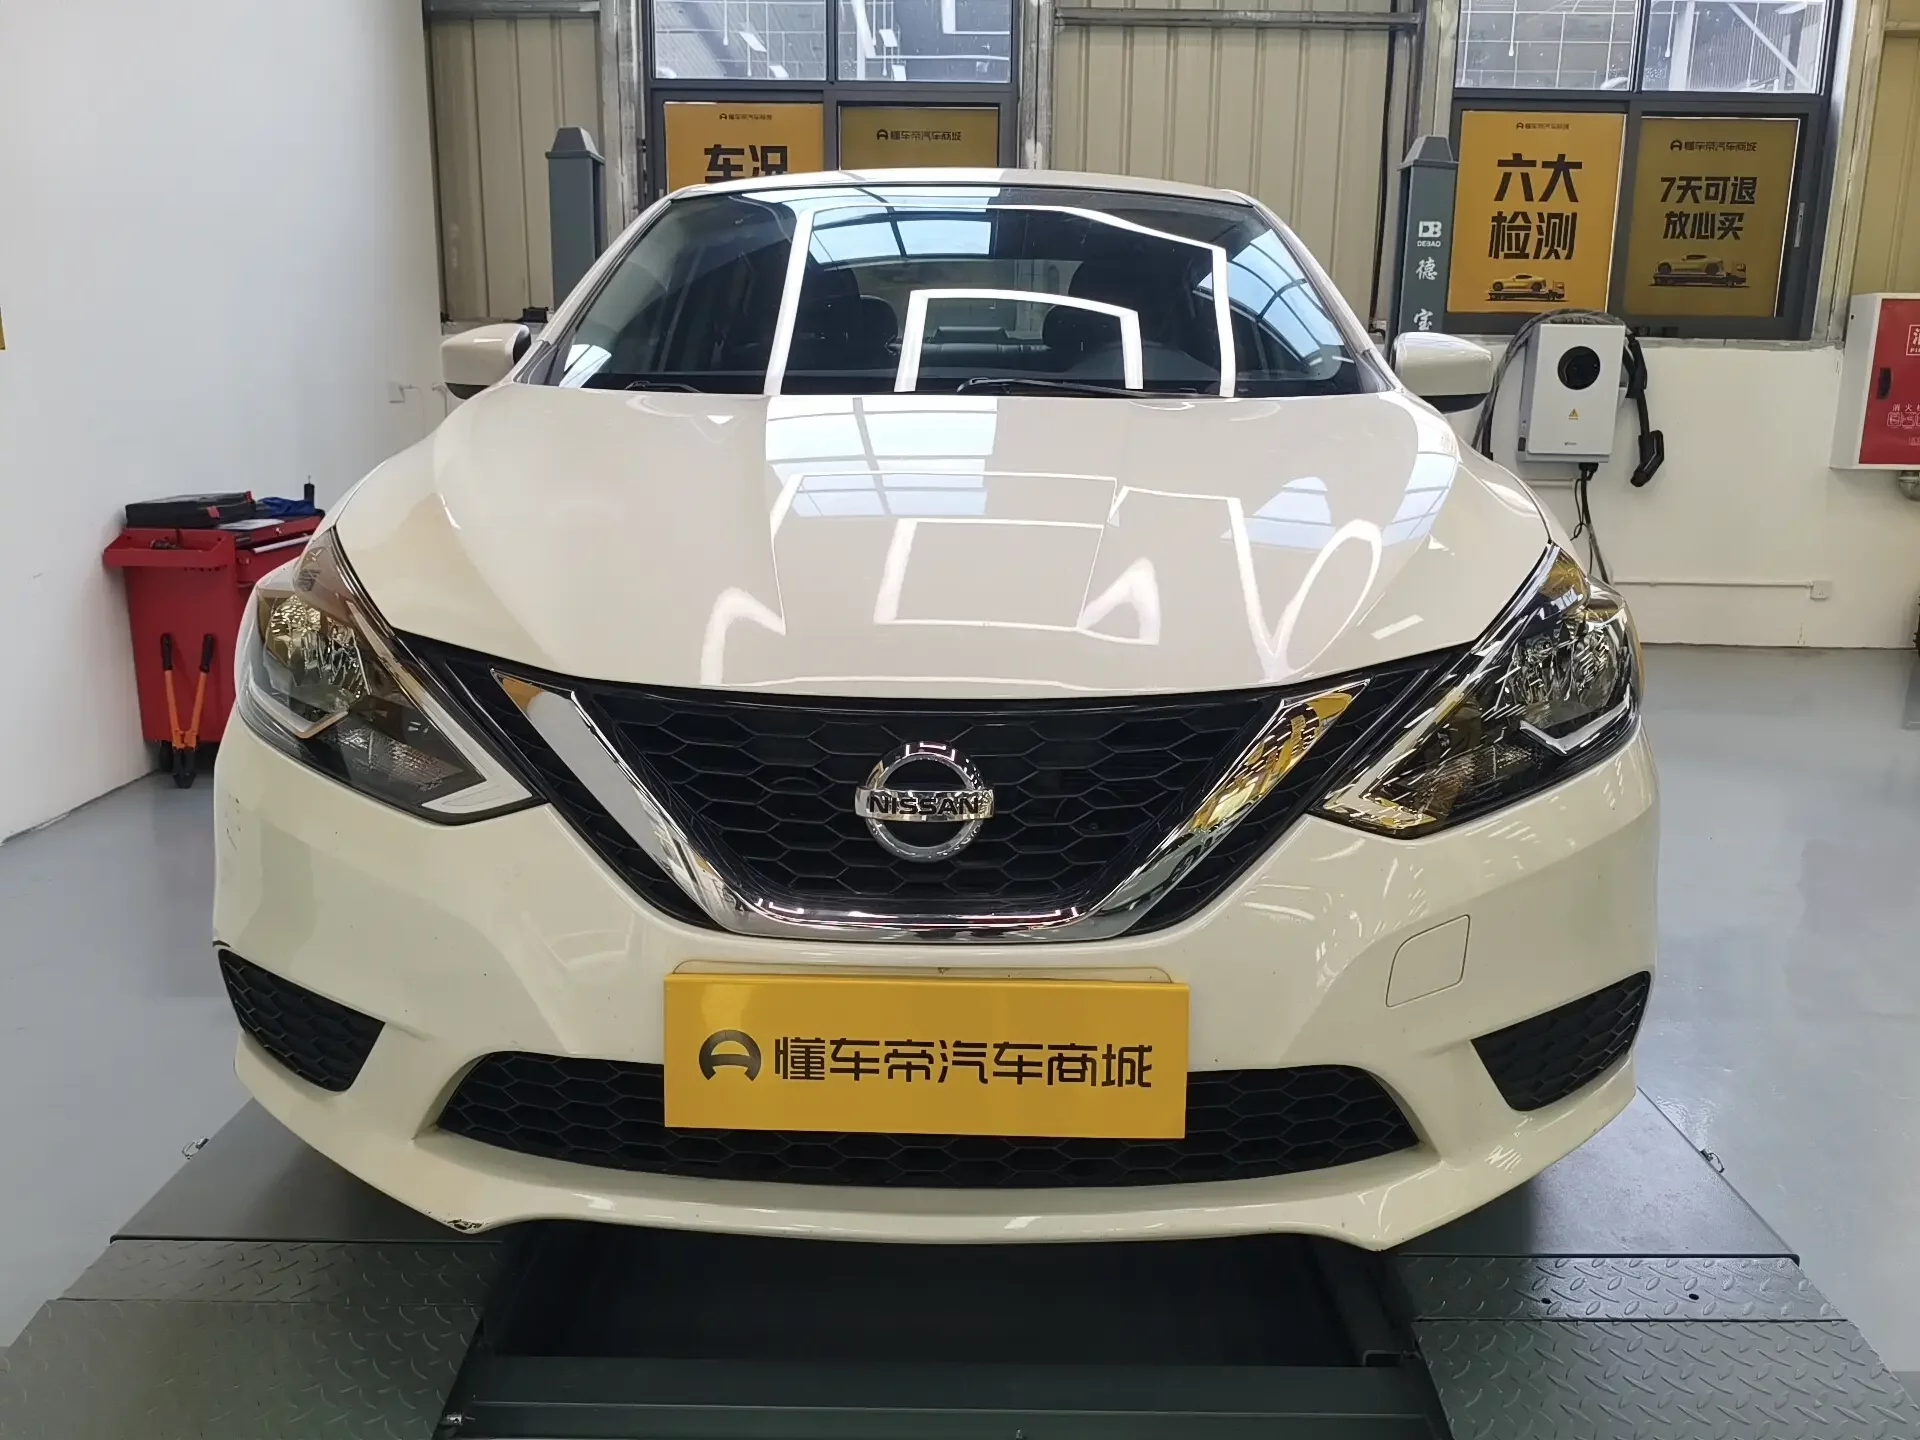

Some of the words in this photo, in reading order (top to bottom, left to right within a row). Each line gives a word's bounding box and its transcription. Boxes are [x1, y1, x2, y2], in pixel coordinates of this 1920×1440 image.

[704, 144, 788, 184] 车况
[1493, 152, 1583, 203] 六大
[1660, 175, 1758, 205] 7天可退
[1488, 210, 1578, 260] 检测
[1662, 210, 1745, 241] 放心买
[869, 794, 979, 815] NISSAN
[773, 1036, 1153, 1088] 懂车帝汽车商城
